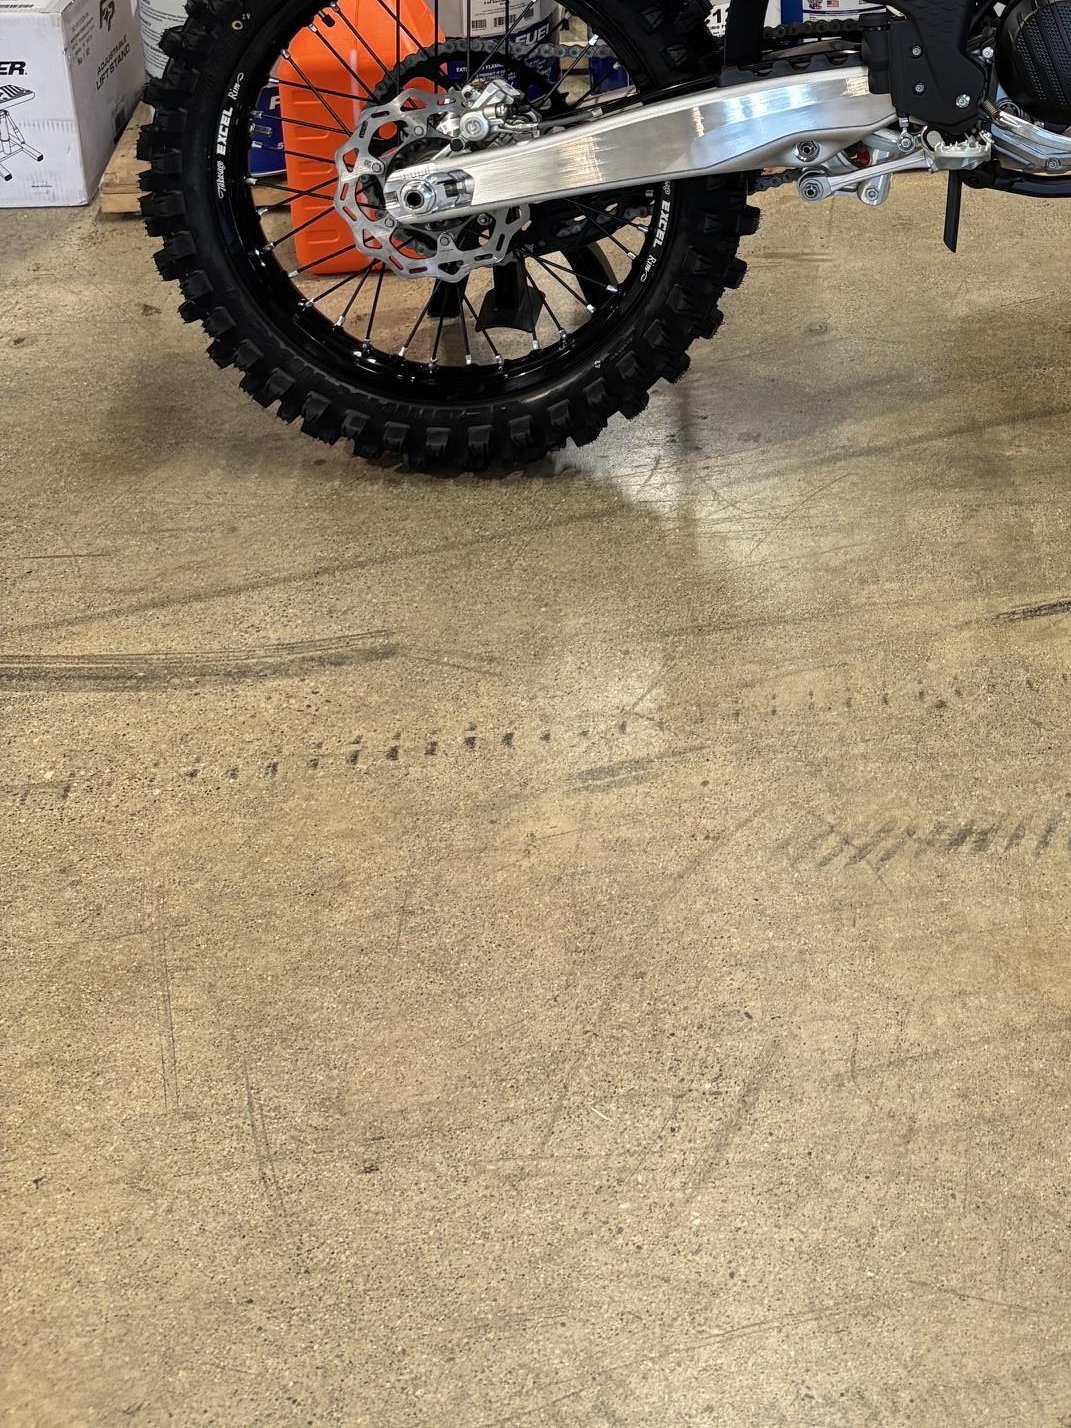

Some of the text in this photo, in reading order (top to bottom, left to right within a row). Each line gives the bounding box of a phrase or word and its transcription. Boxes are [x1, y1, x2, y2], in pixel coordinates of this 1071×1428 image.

[96, 43, 131, 90] LIFT STAND
[98, 34, 127, 75] ADJUSTABLE
[216, 107, 233, 156] EXCEL
[227, 72, 244, 101] Rim
[652, 200, 671, 248] EXCEL
[640, 254, 657, 282] Rim
